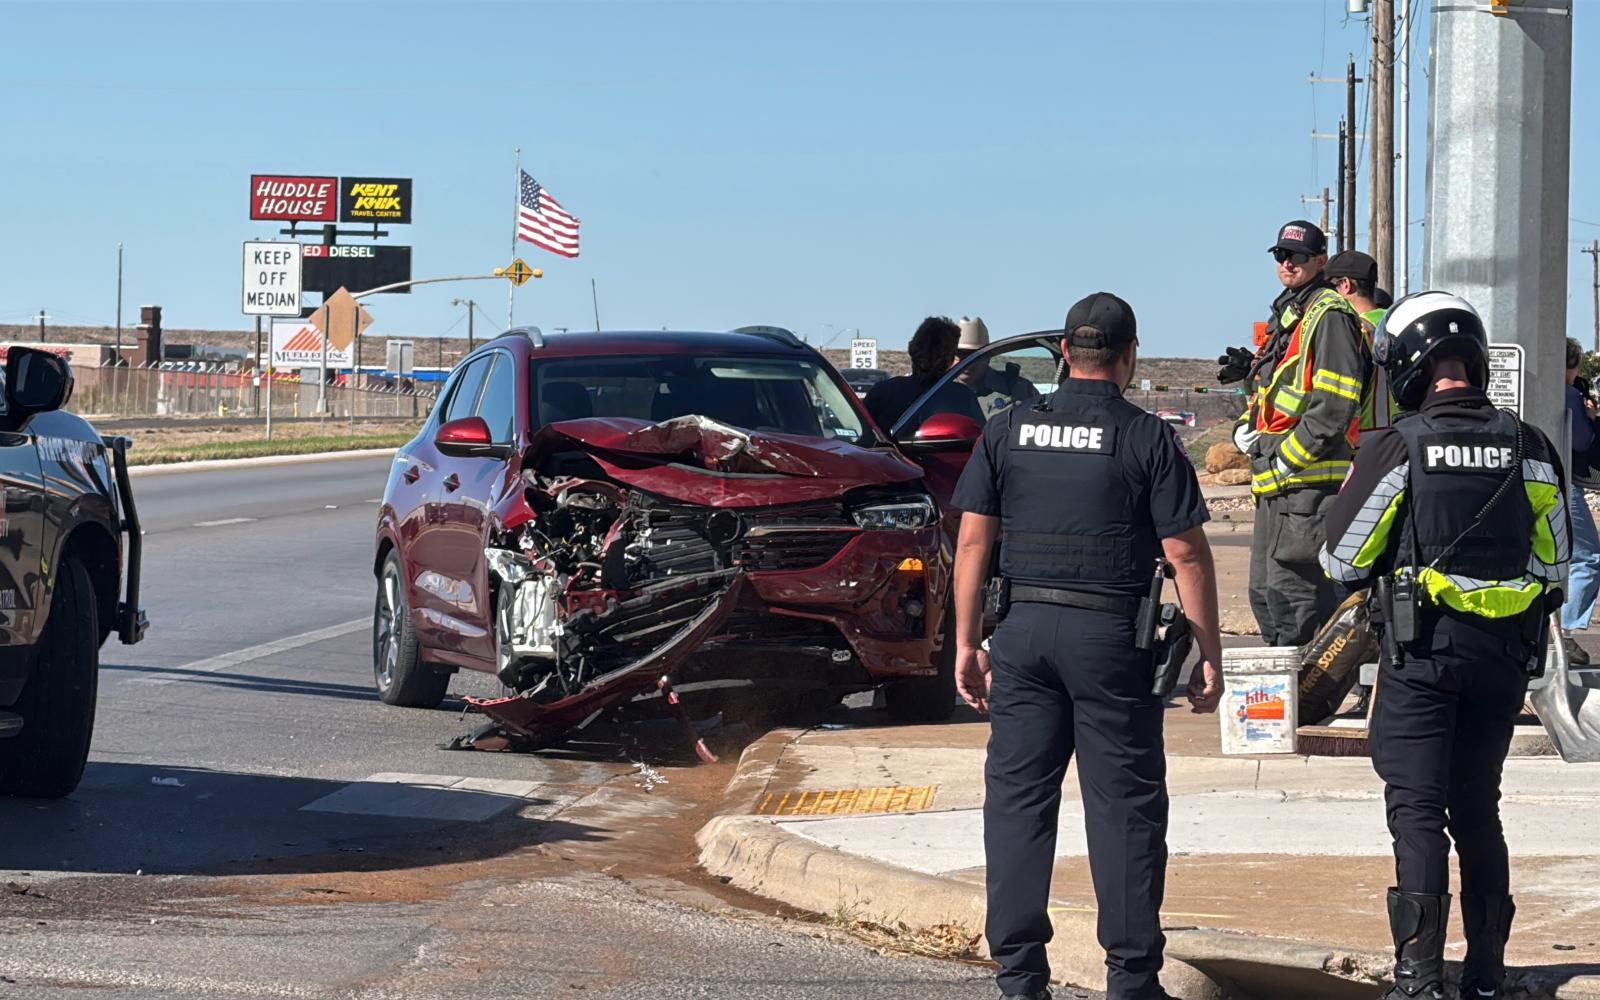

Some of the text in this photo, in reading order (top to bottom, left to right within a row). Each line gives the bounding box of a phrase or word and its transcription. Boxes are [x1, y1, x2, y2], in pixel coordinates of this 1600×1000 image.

[257, 181, 331, 198] HUDDLE
[350, 183, 398, 197] KENT
[260, 199, 326, 216] HOUSE
[254, 250, 292, 265] KEEP
[303, 245, 375, 258] ED DIESEL
[259, 271, 287, 286] OFF
[246, 291, 296, 307] MEDIAN
[856, 358, 872, 368] 55
[1019, 424, 1104, 449] POLICE
[1427, 445, 1512, 468] POLICE
[1245, 689, 1269, 705] hth
